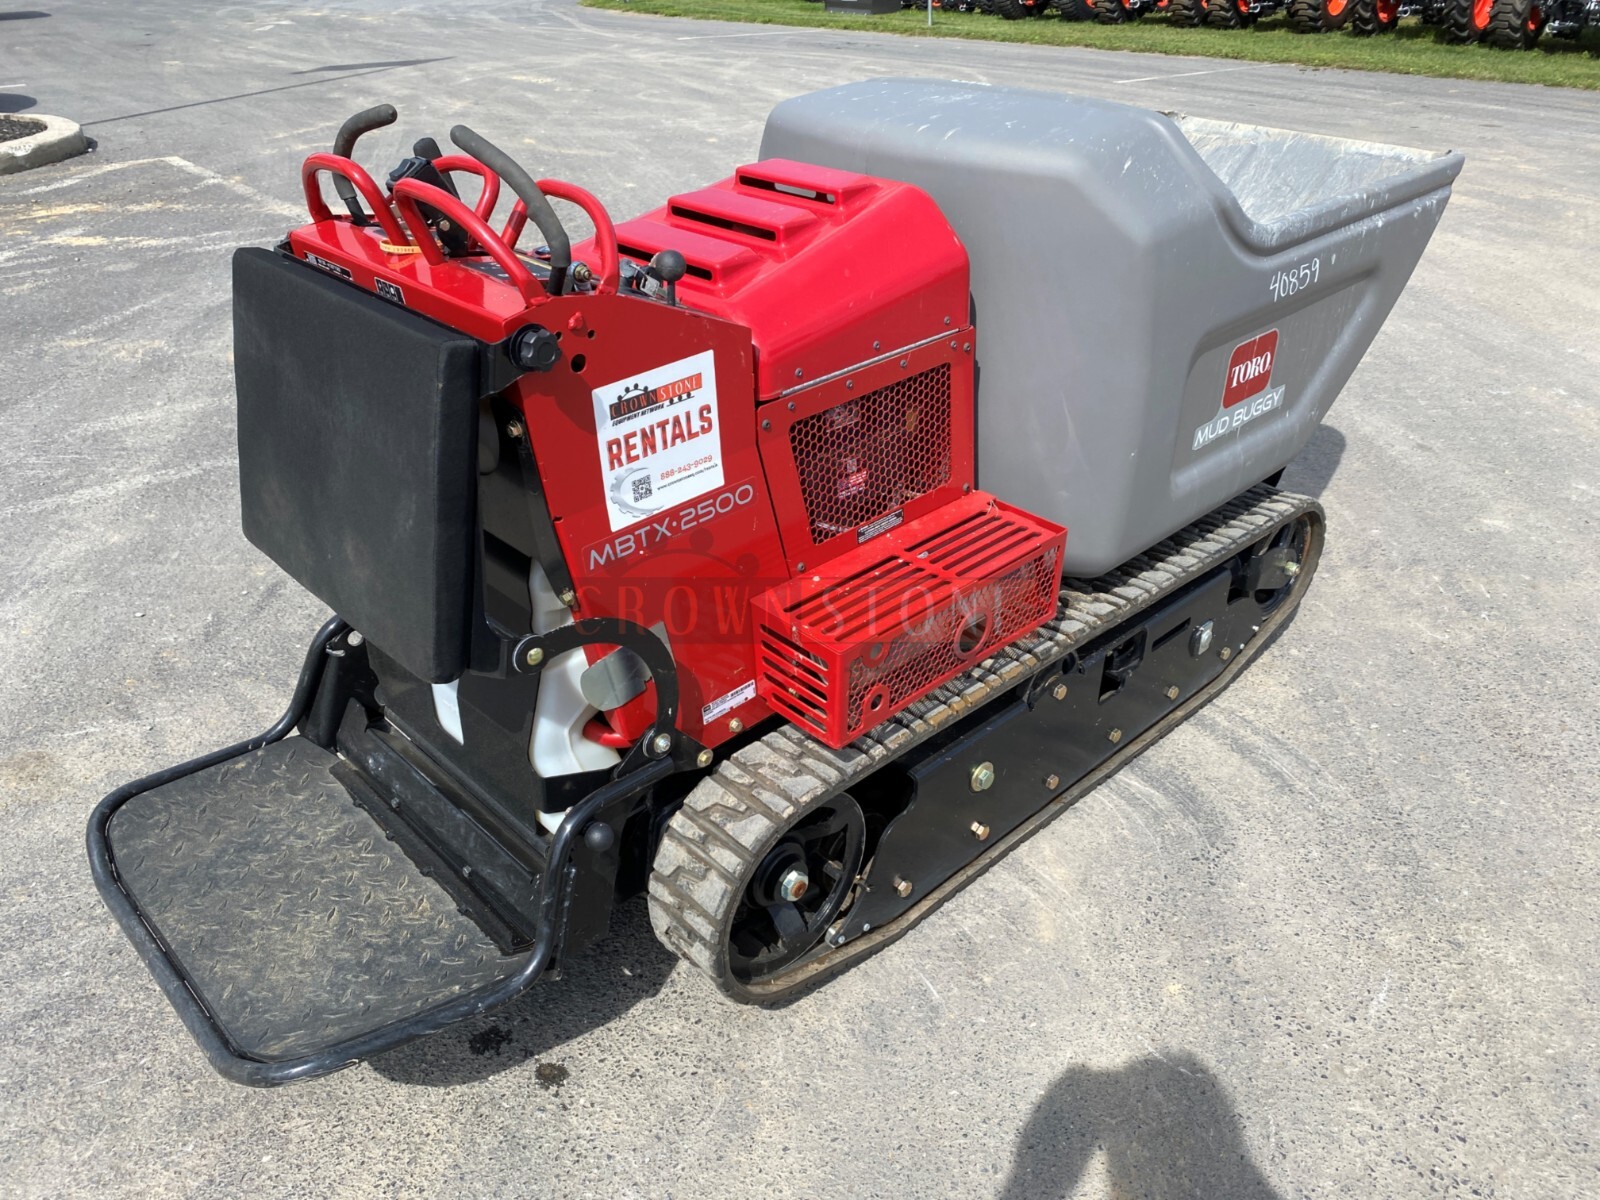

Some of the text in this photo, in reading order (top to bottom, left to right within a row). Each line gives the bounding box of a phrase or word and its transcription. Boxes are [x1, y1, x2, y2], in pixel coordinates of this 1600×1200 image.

[1269, 258, 1320, 302] 40859
[1230, 351, 1271, 388] TORO
[641, 403, 665, 416] NETWORK
[1194, 388, 1284, 447] MUD BUGGY
[605, 403, 713, 471] RENTALS
[660, 454, 713, 480] 888-243-9029
